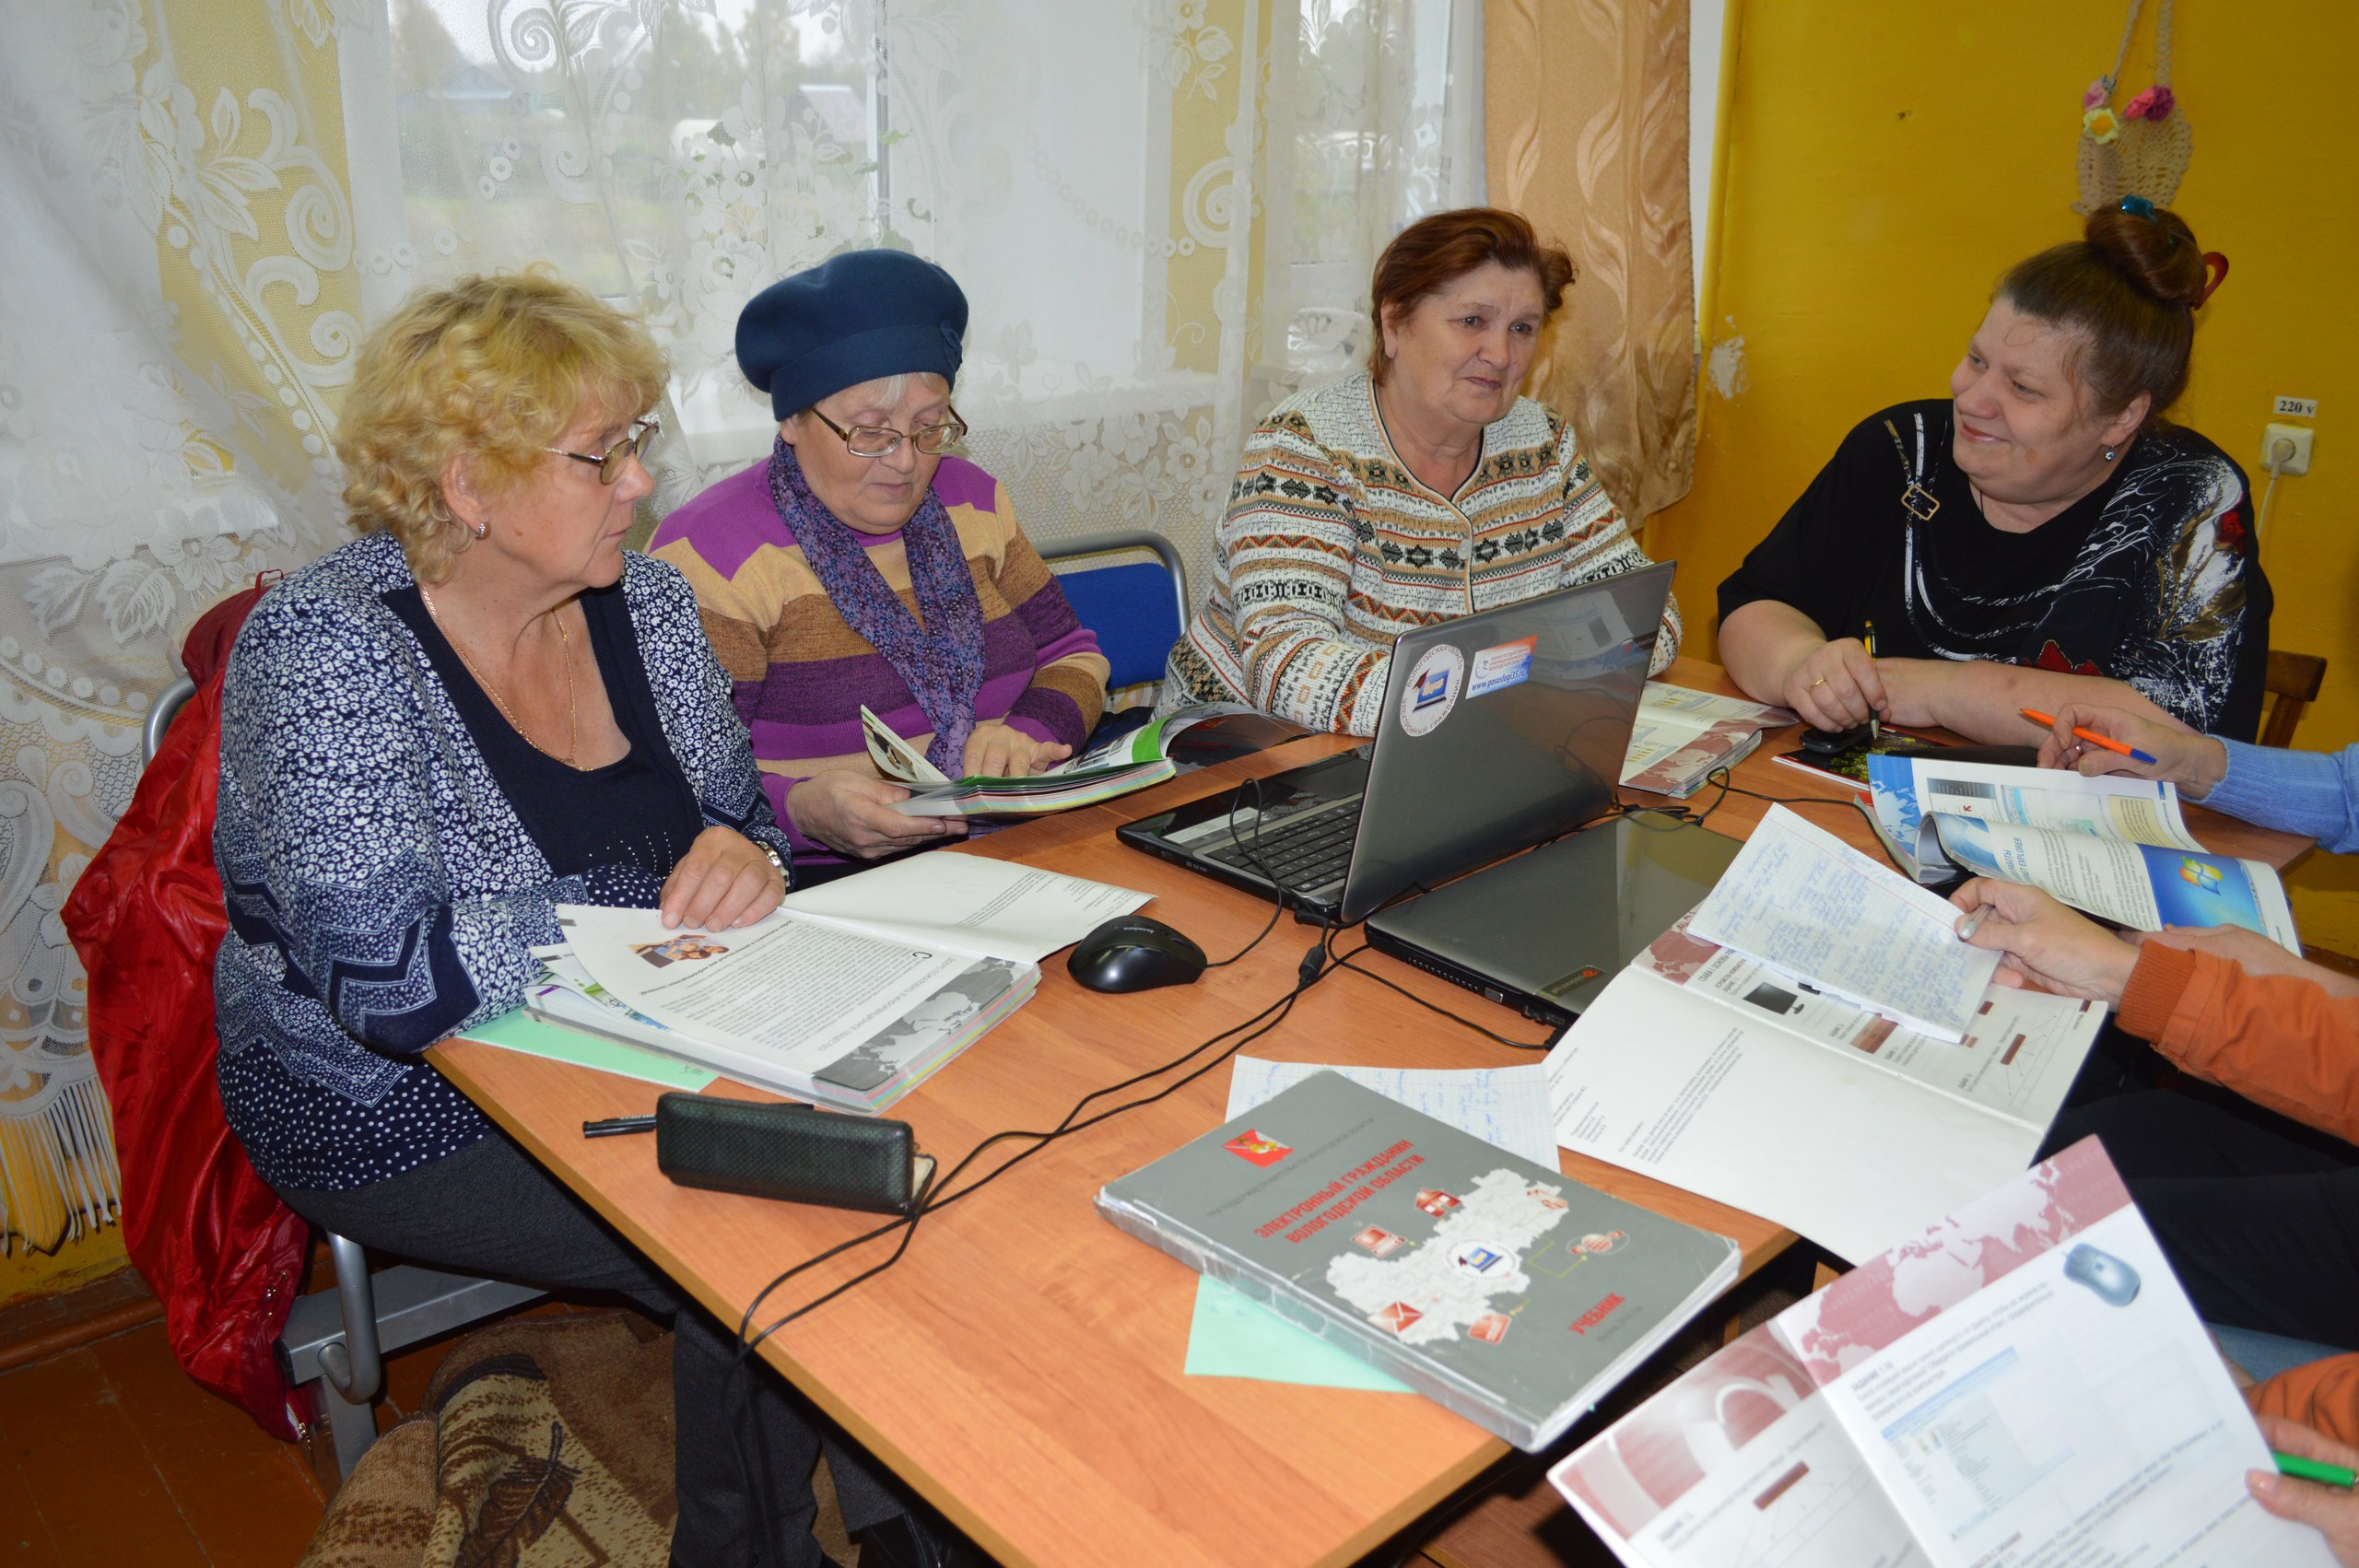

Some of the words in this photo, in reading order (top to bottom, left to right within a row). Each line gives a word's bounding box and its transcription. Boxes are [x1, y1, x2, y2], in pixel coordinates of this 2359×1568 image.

[2279, 400, 2303, 414] 220
[1472, 670, 1525, 690] www.gosuslugi35.ru
[2013, 837, 2025, 867] EXPLORER
[1254, 1178, 1347, 1238] ЭЛЕКТРОННЫЙ
[1342, 1140, 1414, 1186] ГРАЖДАНИН
[1285, 1183, 1376, 1244] ВОЛОГОДСКОЙ
[1370, 1154, 1425, 1189] ОБЛАСТИ
[1568, 1293, 1625, 1336] УЧЕБНИК
